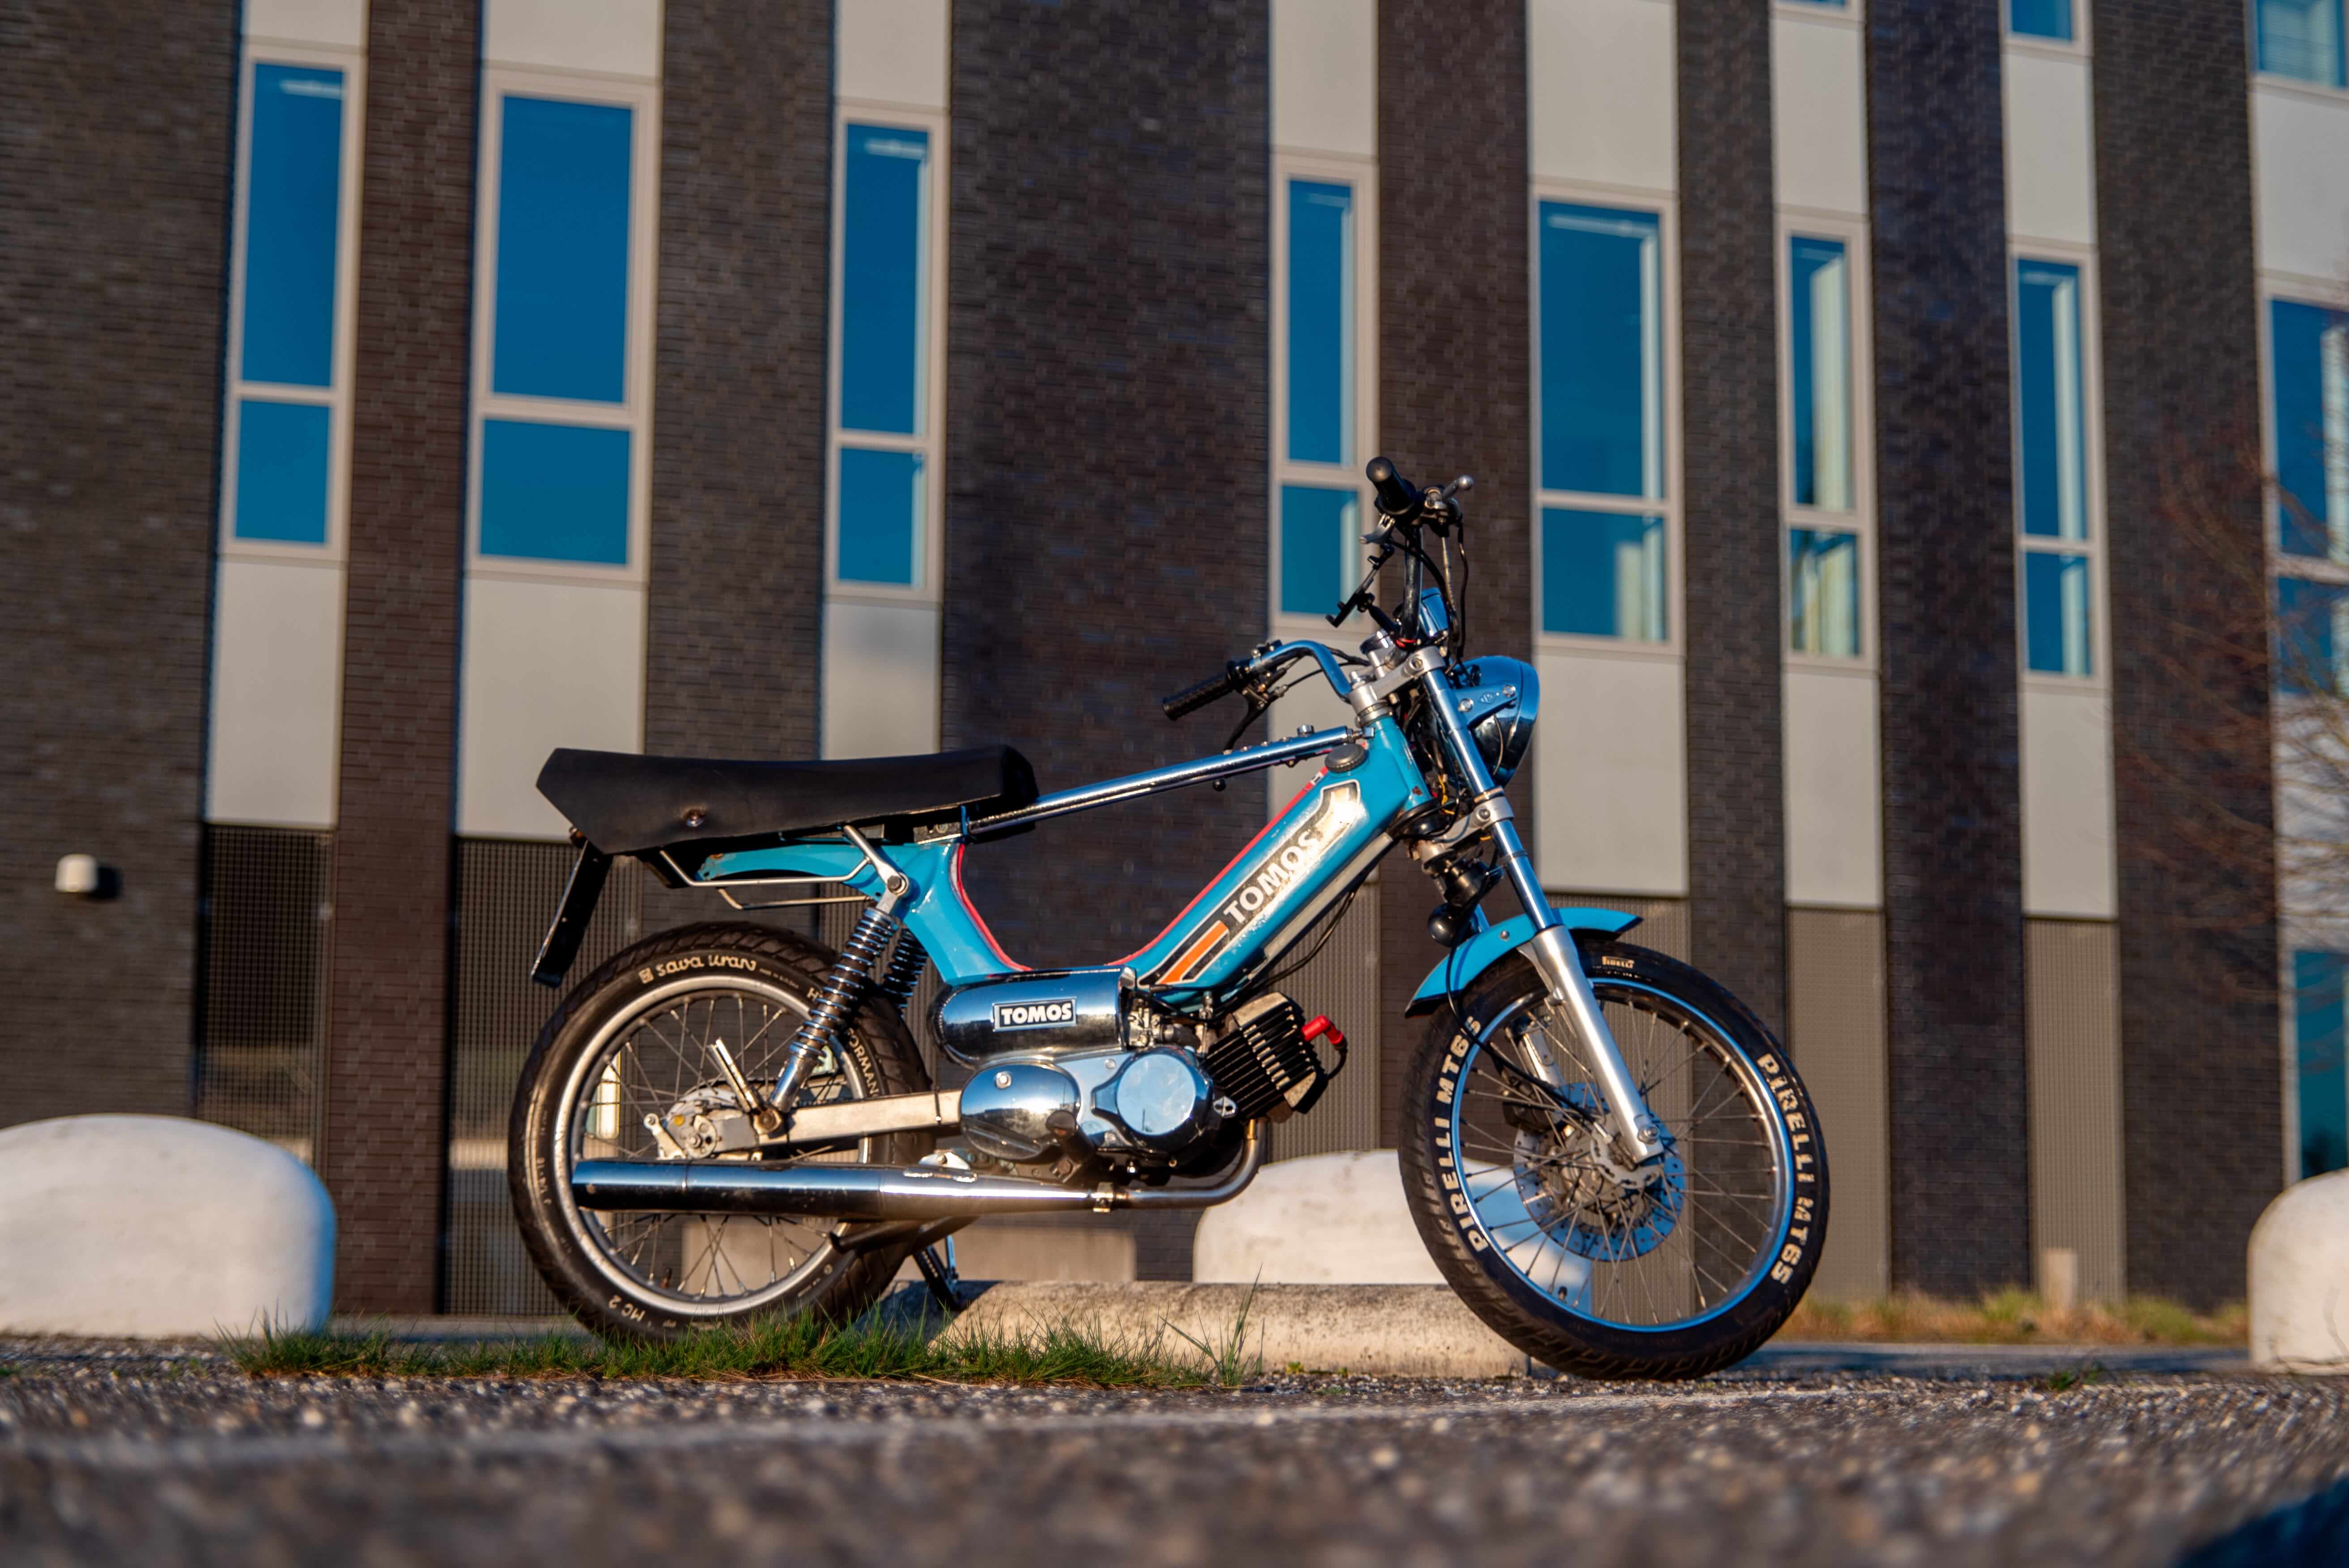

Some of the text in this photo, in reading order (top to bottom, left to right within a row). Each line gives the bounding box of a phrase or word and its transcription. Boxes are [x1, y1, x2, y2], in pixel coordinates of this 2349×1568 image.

[1223, 829, 1320, 924] TOMOS
[1001, 1002, 1072, 1025] TOMOS
[1435, 1117, 1489, 1252] PIRELLI
[1757, 1053, 1815, 1285] PIRELLI MT65
